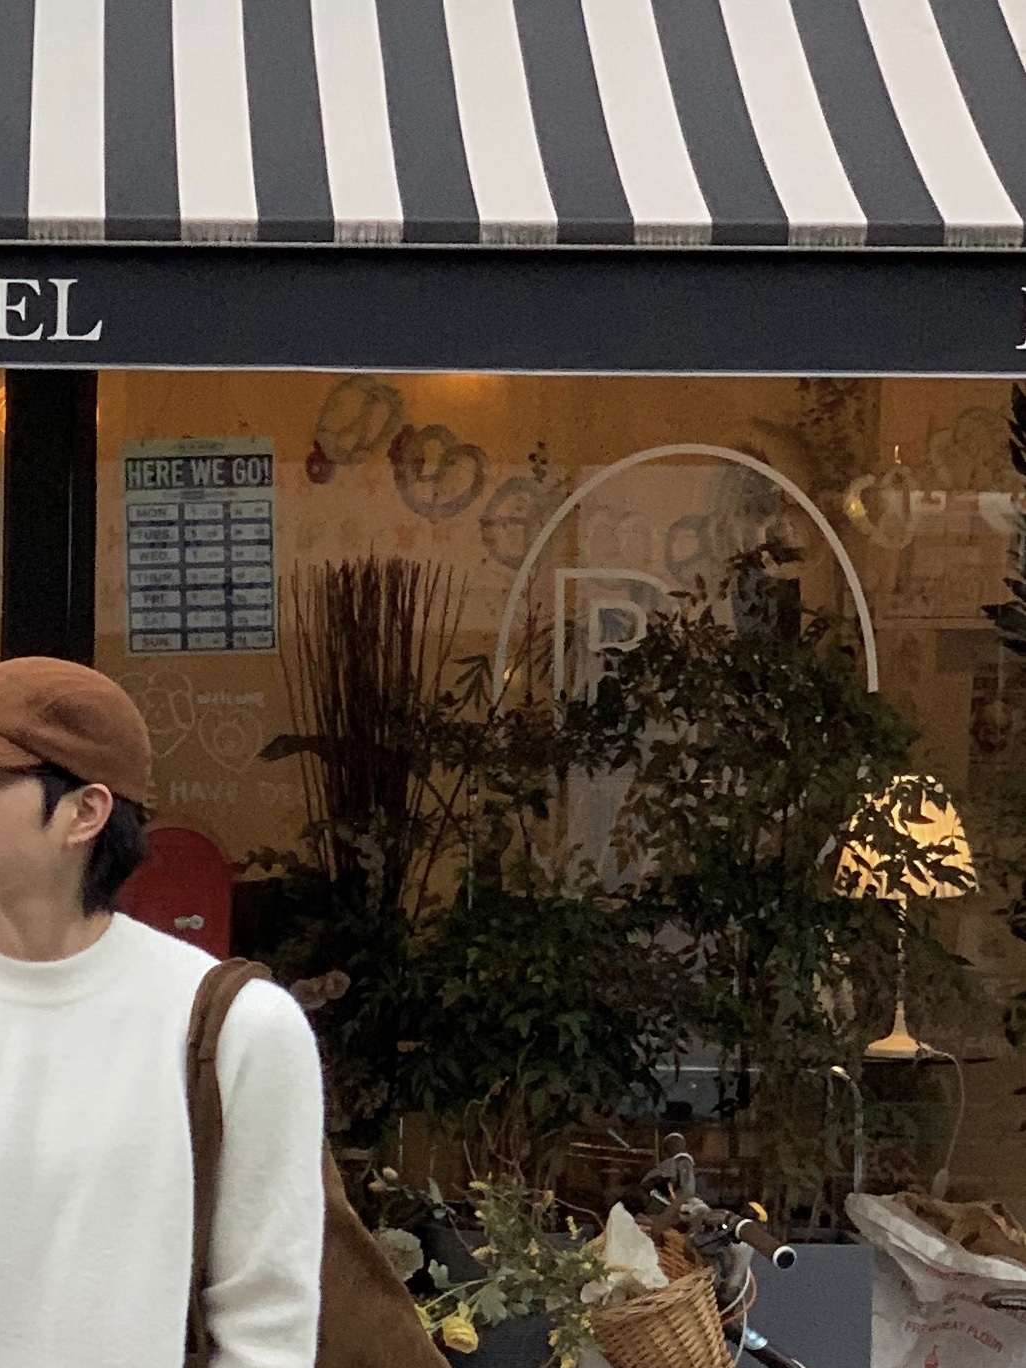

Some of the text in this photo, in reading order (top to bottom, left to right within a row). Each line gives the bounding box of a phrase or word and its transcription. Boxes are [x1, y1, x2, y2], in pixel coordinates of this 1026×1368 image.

[128, 456, 271, 487] HERE WE GO!
